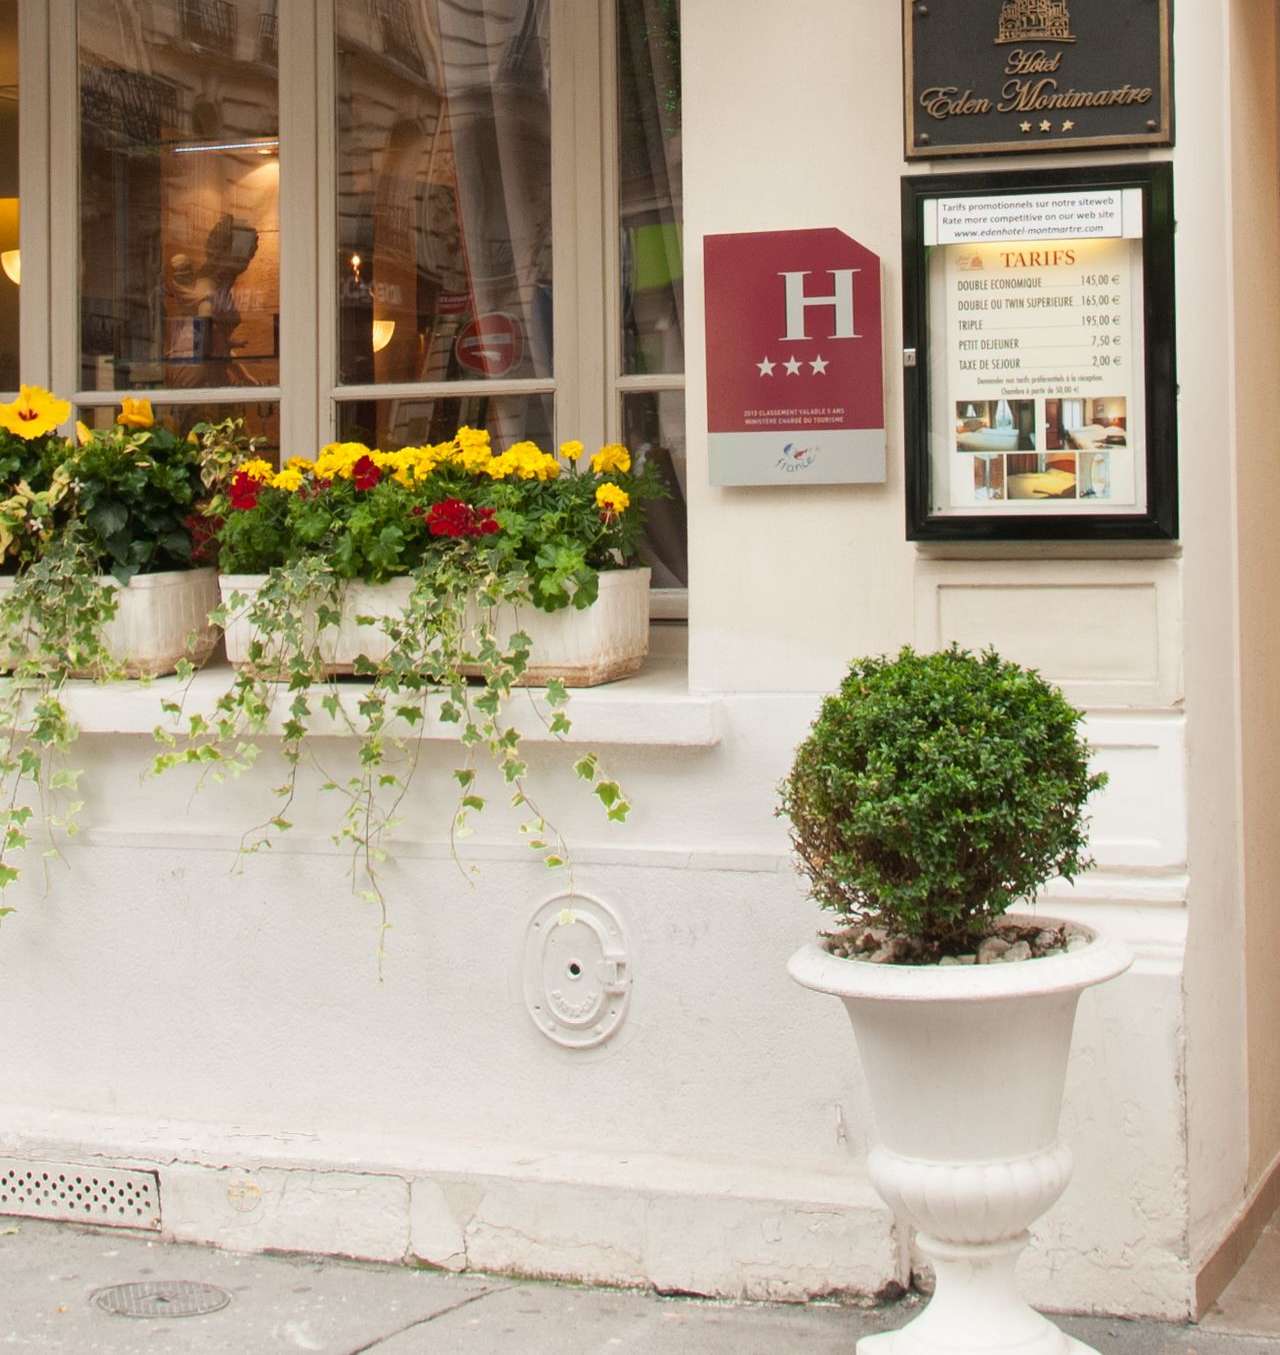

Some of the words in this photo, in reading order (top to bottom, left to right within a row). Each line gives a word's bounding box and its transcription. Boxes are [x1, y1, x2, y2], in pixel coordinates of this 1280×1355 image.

[920, 87, 992, 119] Eden
[997, 79, 1152, 112] Montmartre
[942, 203, 966, 212] Tarifs
[968, 200, 1033, 212] promotionnels
[1035, 200, 1049, 208] sur
[1051, 198, 1076, 207] notre
[1078, 196, 1114, 206] siteweb
[942, 217, 962, 225] Rate
[964, 216, 987, 224] more
[990, 213, 1042, 225] competitive
[1058, 212, 1073, 220] our
[1076, 211, 1096, 220] web
[1098, 210, 1115, 219] site
[954, 225, 1104, 237] www.edenhotel-montmartre.com
[1000, 249, 1076, 268] TARIFS
[958, 280, 988, 291] DOUBLE
[990, 277, 1042, 290] ECONOMIQUE
[1081, 275, 1109, 286] 145,00
[1111, 275, 1120, 285] €
[777, 268, 863, 341] H
[958, 300, 988, 311] DOUBLE
[990, 299, 1002, 310] OU
[1005, 298, 1024, 309] TWIN
[1027, 296, 1073, 308] SUPERIEURE
[1081, 295, 1109, 307] 165,00
[1112, 295, 1121, 305] €
[958, 320, 983, 330] TRIPLE
[1081, 315, 1110, 327] 195,00
[1112, 315, 1121, 325] €
[958, 340, 978, 351] PETIT
[981, 339, 1019, 350] DEJEUNER
[1091, 335, 1110, 347] 7,50
[1112, 335, 1121, 345] €
[959, 360, 977, 371] TAXE
[979, 359, 990, 370] DE
[991, 358, 1021, 370] SEJOUR
[1092, 356, 1110, 367] 2,00
[1112, 356, 1122, 366] €
